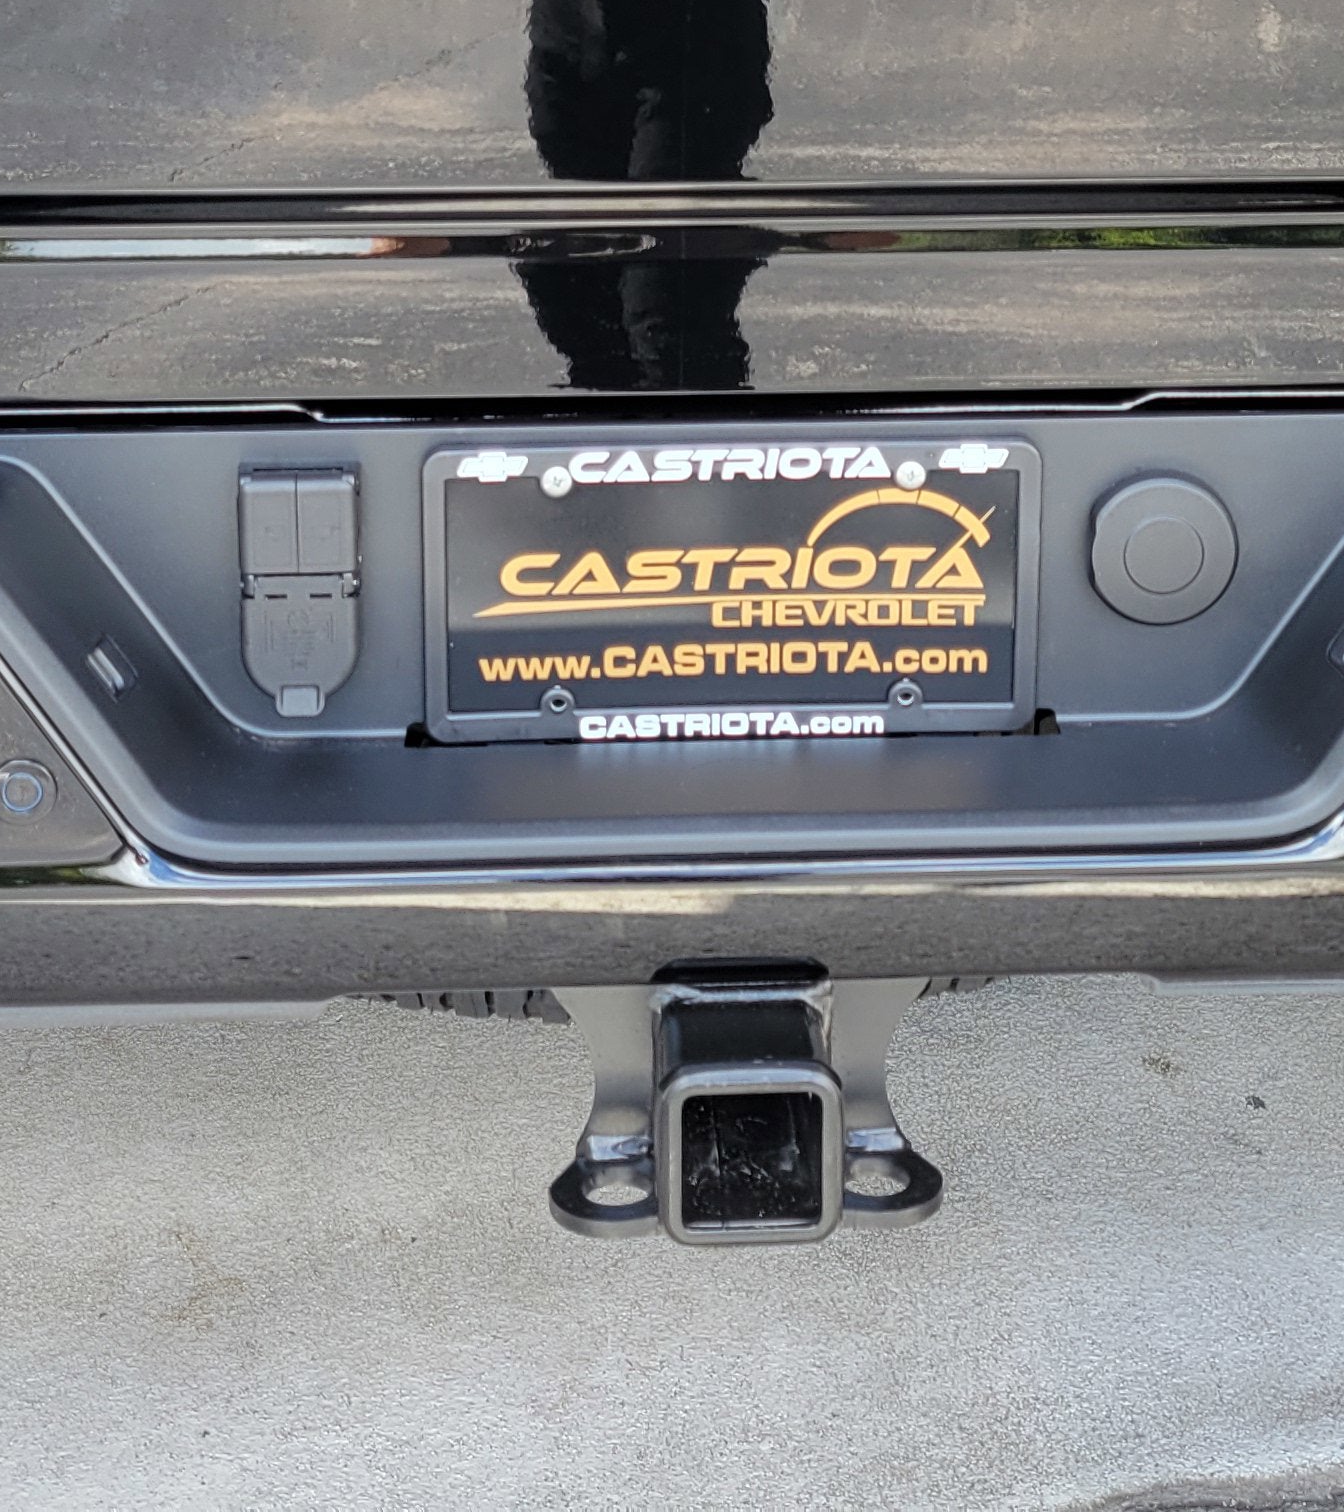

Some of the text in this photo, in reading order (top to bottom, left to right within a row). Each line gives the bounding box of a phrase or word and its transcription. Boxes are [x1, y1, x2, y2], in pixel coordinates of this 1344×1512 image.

[568, 446, 892, 483] CASTRIOTA
[499, 545, 986, 596] CASTRIOTA
[710, 598, 984, 629] CHEVROLET
[478, 640, 989, 683] www.CASTRIOTA.com
[578, 710, 885, 741] CASTRIOTA.com
